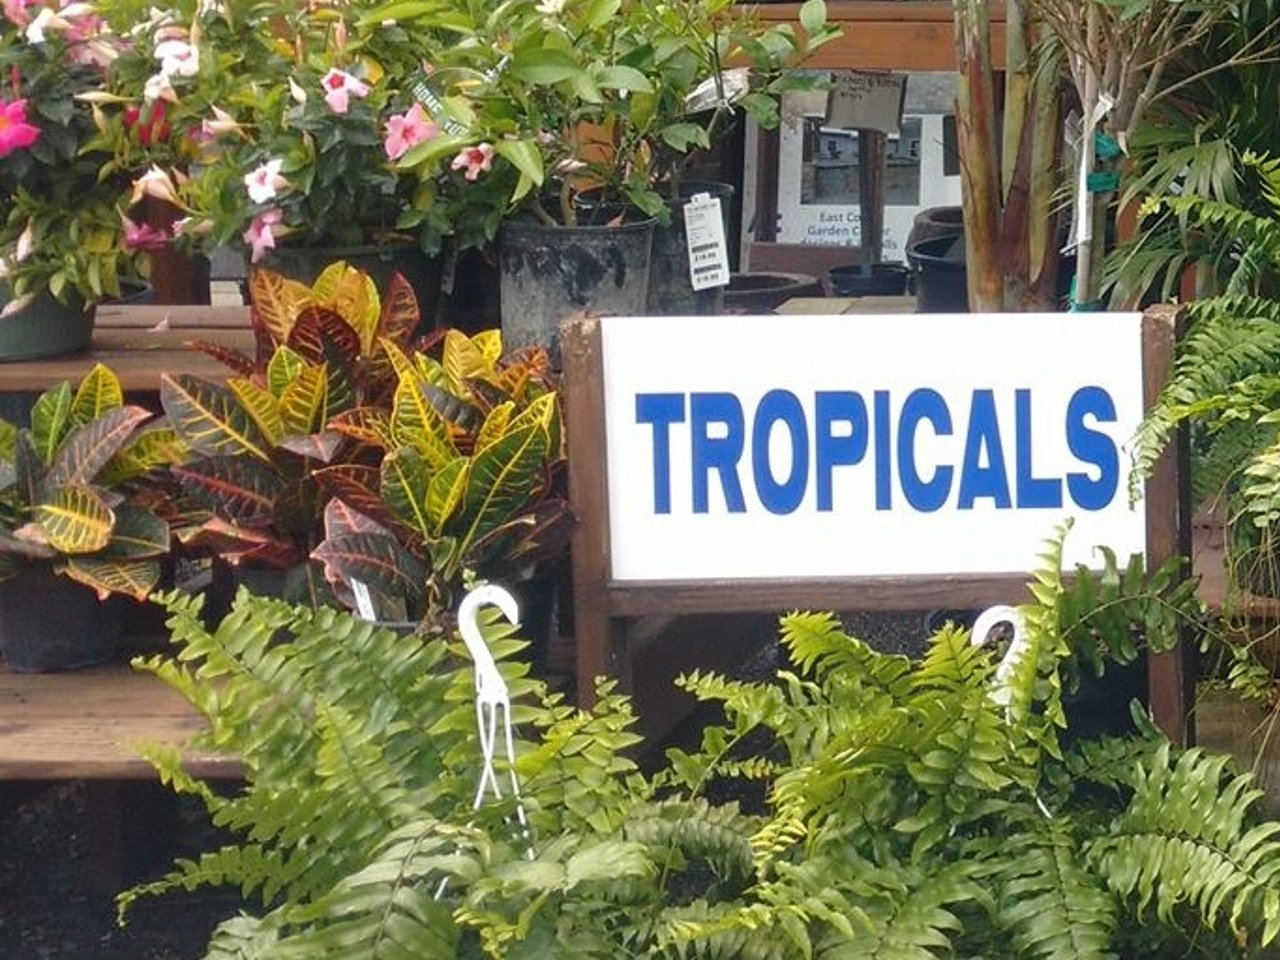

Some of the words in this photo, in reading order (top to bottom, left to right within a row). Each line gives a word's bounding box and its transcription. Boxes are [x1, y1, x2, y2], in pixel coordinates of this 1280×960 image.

[820, 212, 843, 222] East
[808, 224, 849, 236] Garden
[635, 385, 1120, 515] TROPICALS
